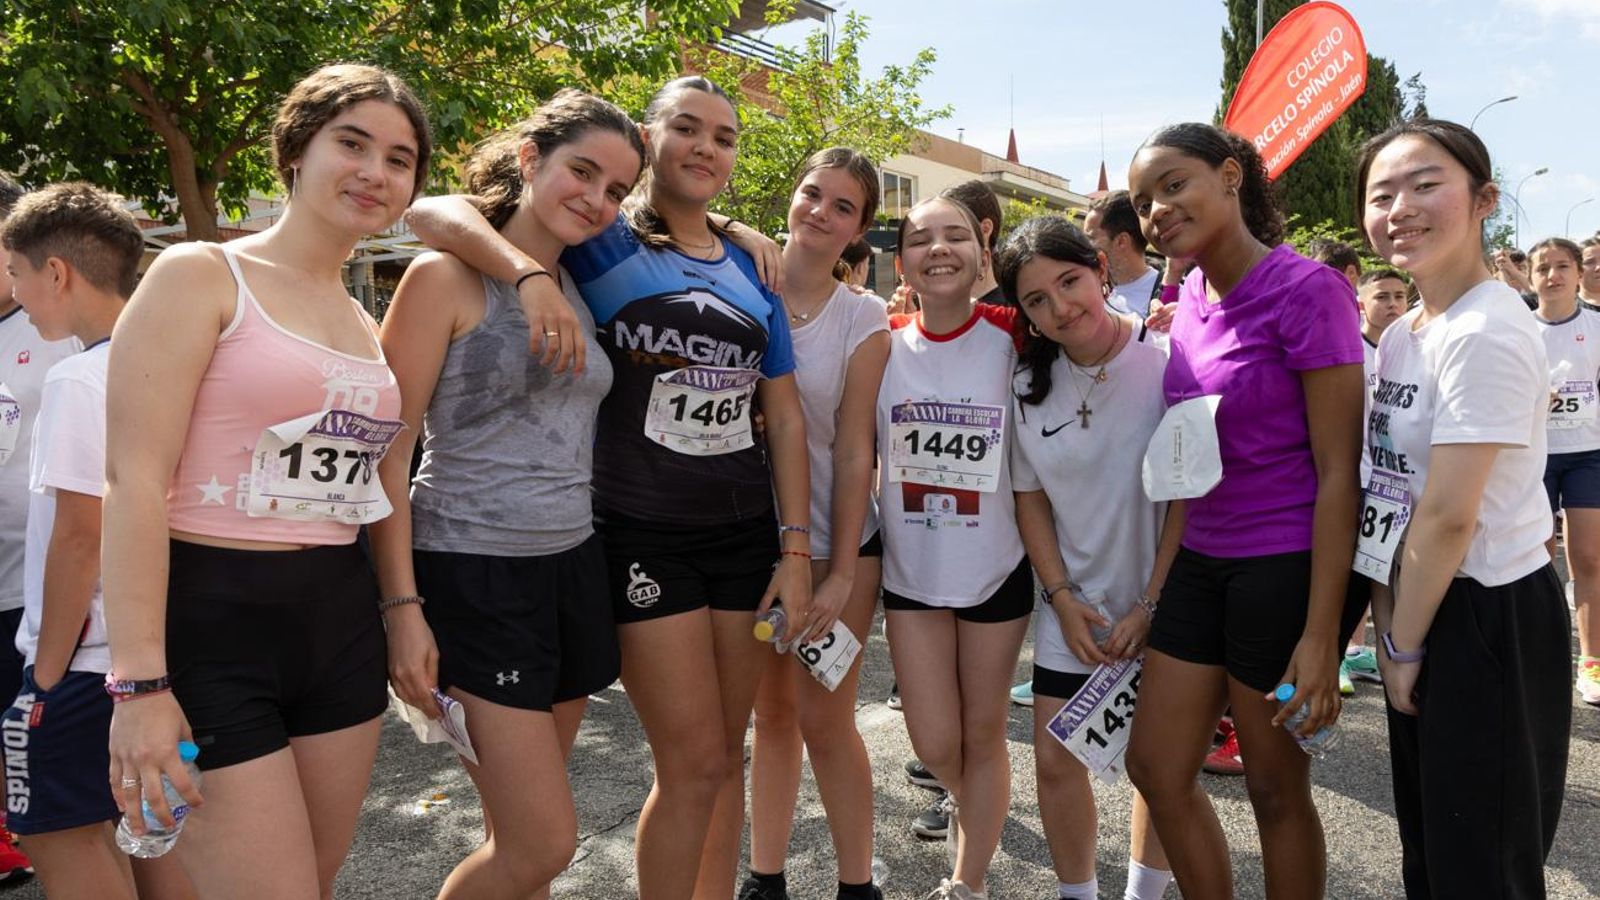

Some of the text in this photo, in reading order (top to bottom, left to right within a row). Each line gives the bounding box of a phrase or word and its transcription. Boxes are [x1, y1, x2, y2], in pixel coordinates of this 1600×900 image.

[1287, 27, 1343, 88] COLEGIO
[1296, 50, 1354, 110] SPÍNOLA
[1297, 100, 1334, 142] Spínola
[1341, 74, 1362, 102] Jaén
[669, 392, 747, 427] 1465
[912, 405, 947, 421] XXXVI
[904, 430, 986, 462] 1449
[1361, 505, 1394, 543] 81
[630, 587, 658, 601] GAB
[2, 692, 36, 815] SPINOLA
